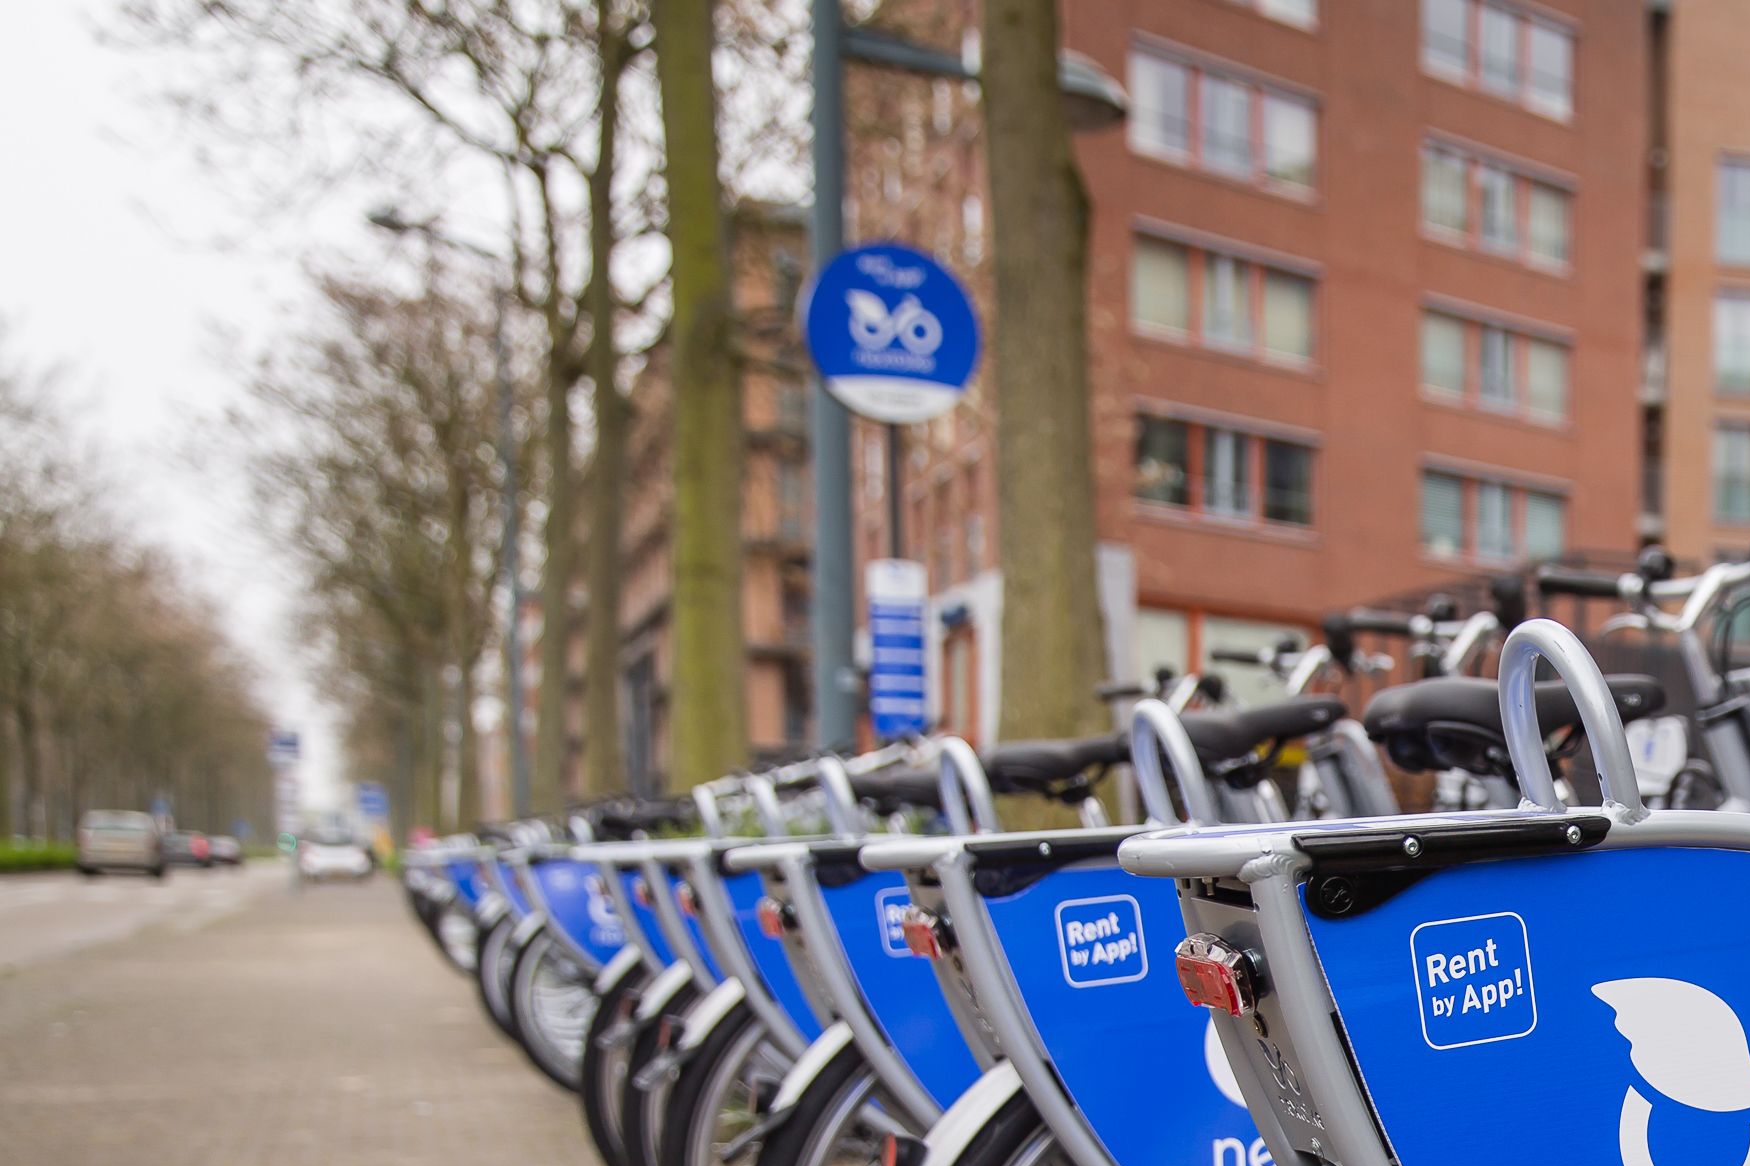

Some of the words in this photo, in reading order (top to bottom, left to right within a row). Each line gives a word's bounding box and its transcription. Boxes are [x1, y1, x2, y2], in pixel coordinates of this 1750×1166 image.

[1066, 911, 1120, 947] Rent
[1070, 948, 1089, 967] by
[1091, 931, 1138, 965] App!
[1425, 938, 1499, 988] Rent
[1432, 995, 1455, 1018] by
[1461, 967, 1524, 1014] App!
